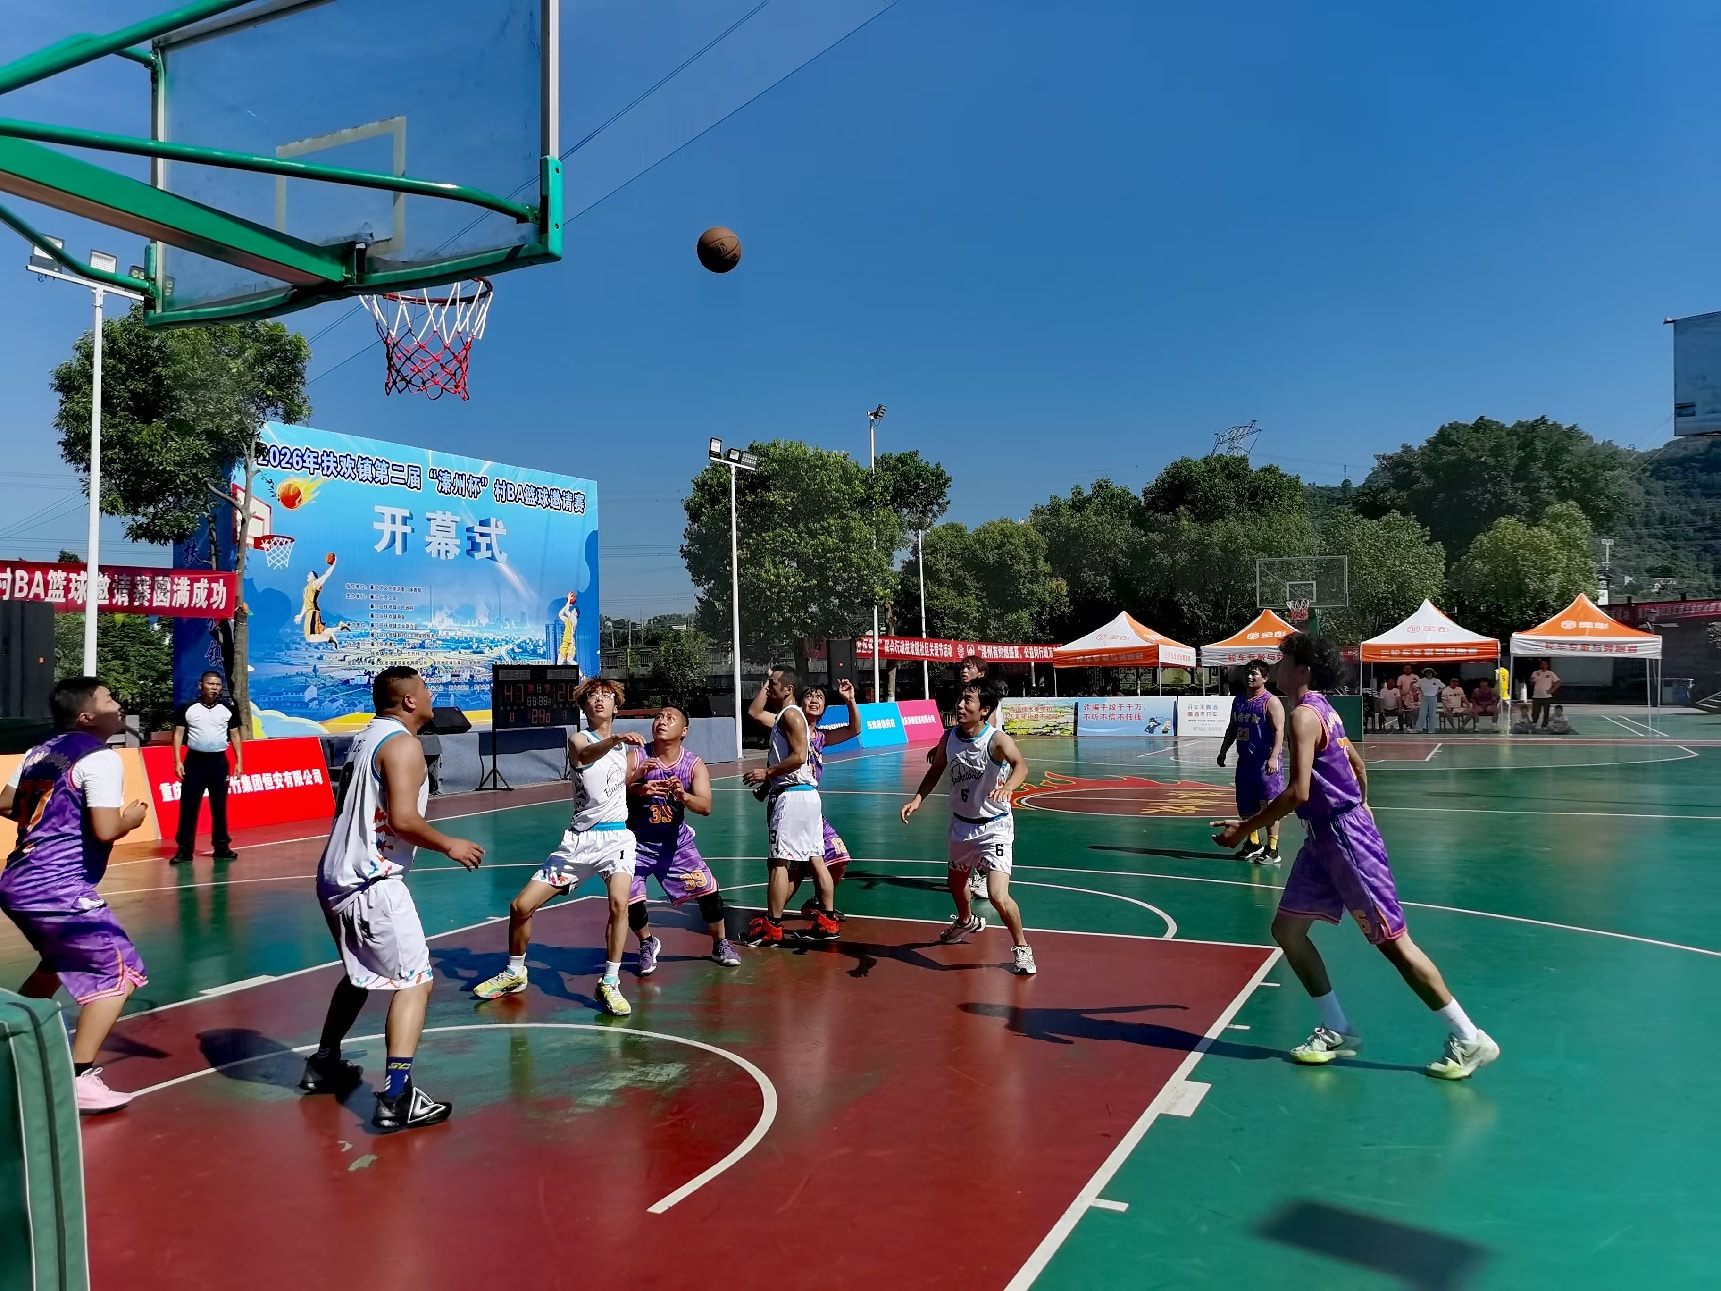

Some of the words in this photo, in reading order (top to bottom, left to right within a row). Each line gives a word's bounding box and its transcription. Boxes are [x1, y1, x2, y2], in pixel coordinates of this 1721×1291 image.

[373, 505, 508, 565] 开幕式
[960, 788, 970, 803] 6
[619, 849, 625, 860] 1
[995, 843, 1004, 857] 6
